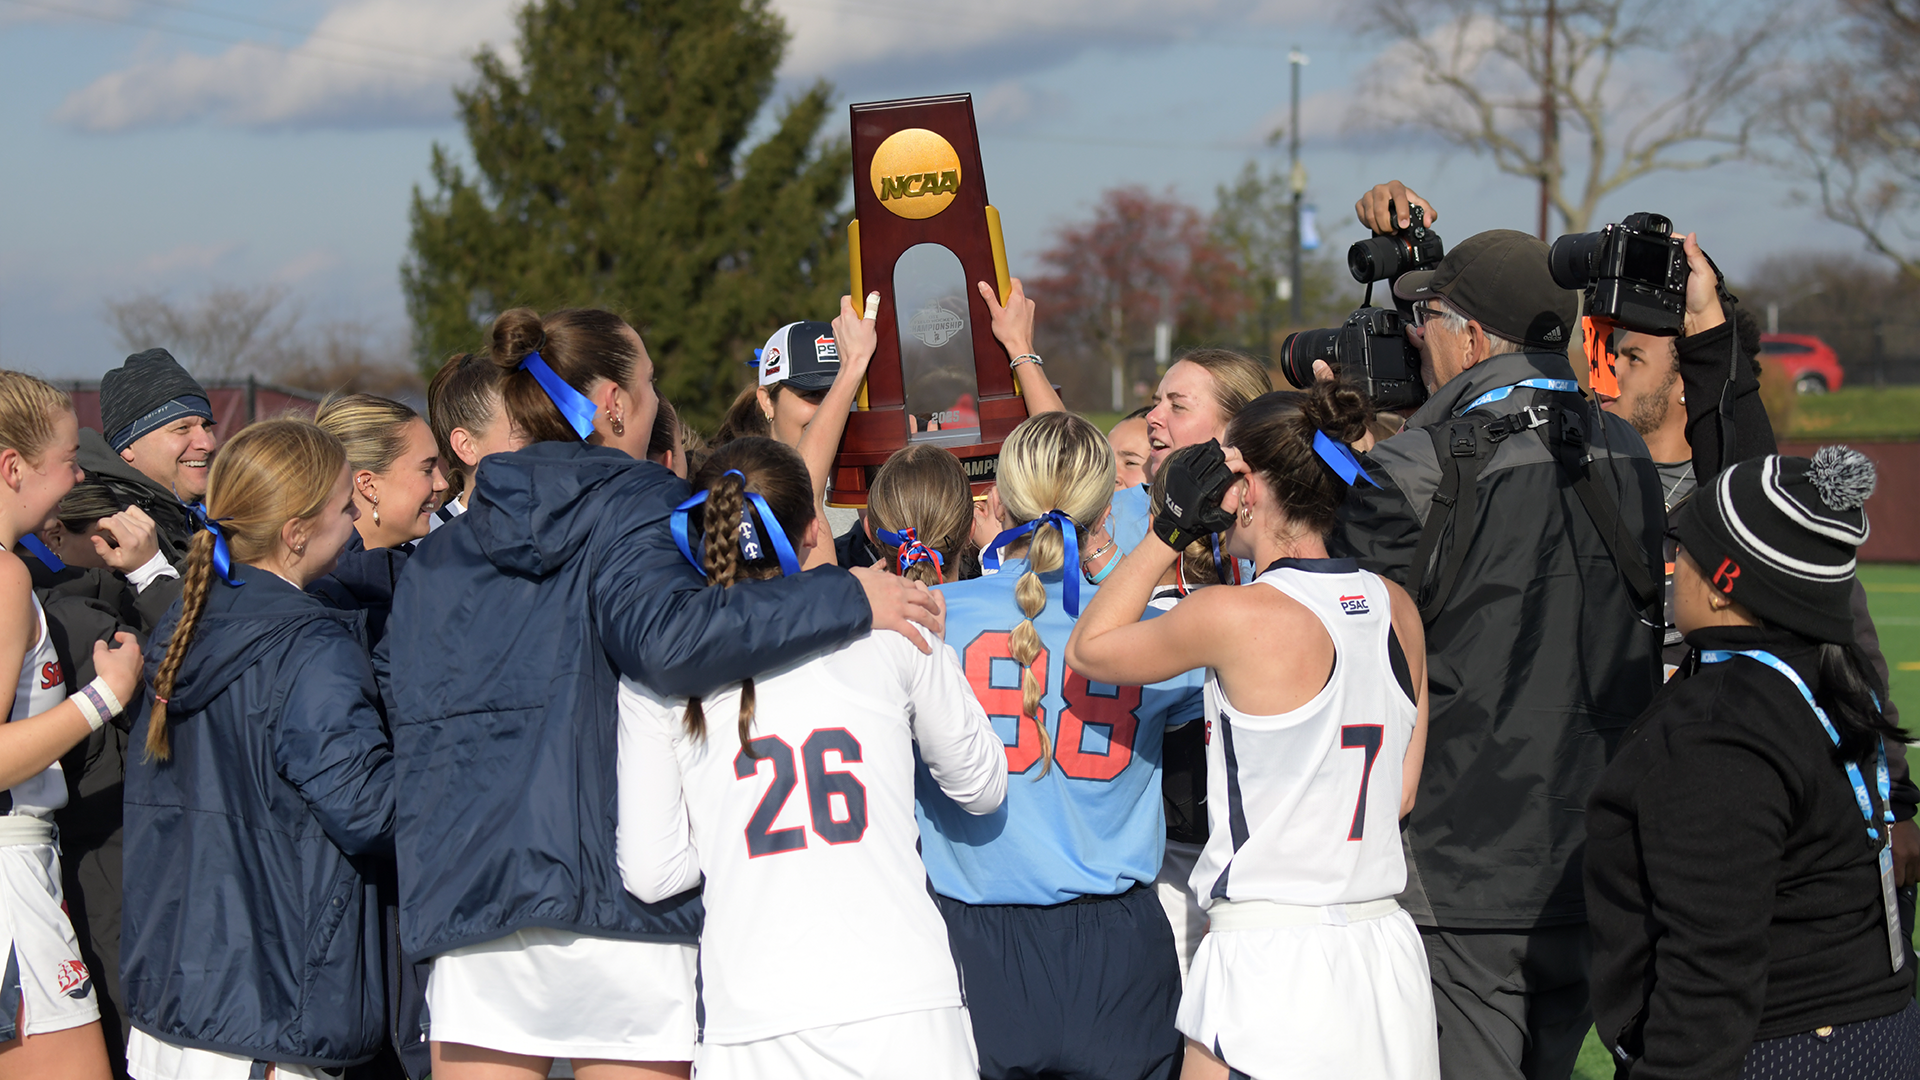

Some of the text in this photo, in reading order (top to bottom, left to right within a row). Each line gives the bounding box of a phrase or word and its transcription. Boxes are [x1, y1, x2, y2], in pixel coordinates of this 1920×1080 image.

[880, 168, 960, 201] NCAA
[818, 345, 837, 354] PS
[931, 410, 960, 425] 2025
[963, 458, 999, 476] AMPI
[1166, 492, 1184, 518] STX
[1712, 554, 1742, 593] B
[1340, 599, 1369, 611] PSAC
[963, 629, 1143, 782] 88
[733, 727, 868, 859] 26
[1340, 723, 1384, 841] 7
